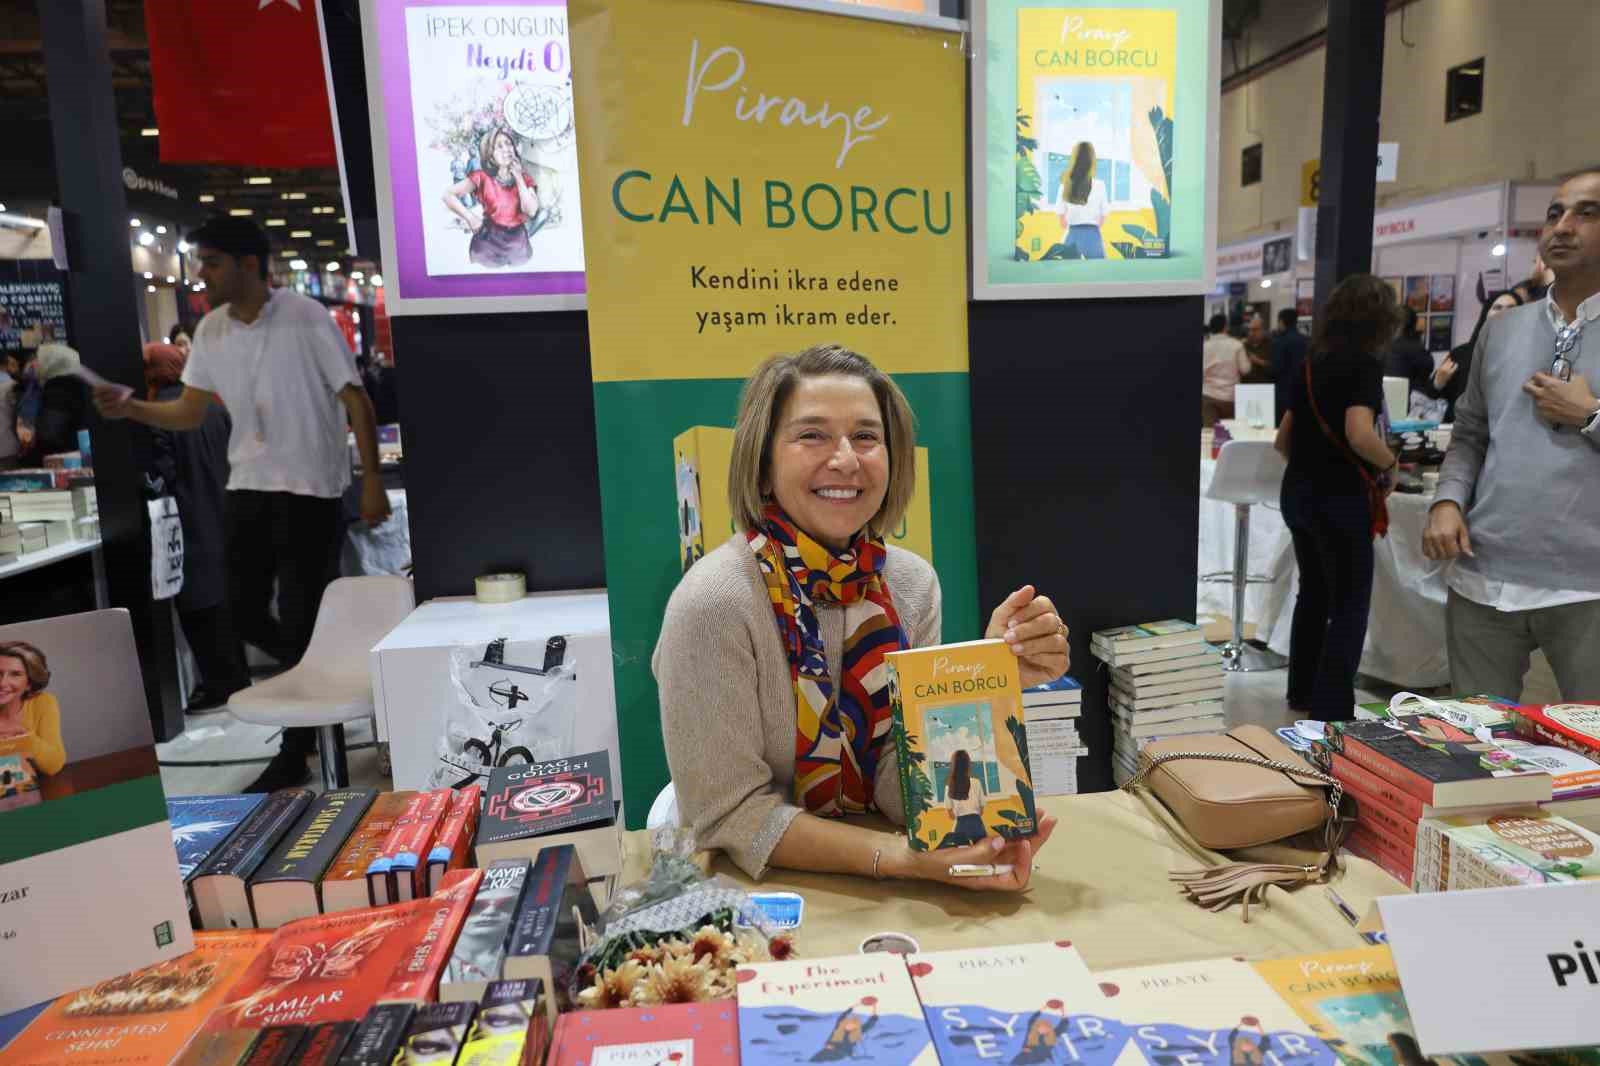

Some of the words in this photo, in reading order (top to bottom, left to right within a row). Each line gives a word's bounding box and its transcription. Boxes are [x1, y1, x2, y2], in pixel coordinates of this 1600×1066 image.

[425, 14, 475, 38] İPEK
[483, 16, 565, 37] ONGUN
[467, 43, 536, 80] Neydi
[1034, 48, 1079, 67] CAN
[1085, 48, 1159, 68] BORCU
[682, 39, 888, 169] Piraye
[611, 169, 742, 226] CAN
[764, 180, 952, 237] BORCU
[690, 265, 779, 291] Kendini
[787, 268, 828, 291] ikra
[836, 269, 900, 292] edene
[695, 308, 767, 334] yaşam
[775, 304, 837, 326] ikram
[845, 304, 897, 326] eder.
[914, 682, 948, 698] CAN
[952, 674, 1008, 694] BORCU
[484, 866, 526, 882] KAYIP
[489, 878, 514, 890] KIZ
[805, 965, 840, 977] The
[761, 971, 885, 996] Experiment
[1288, 976, 1337, 993] CAN
